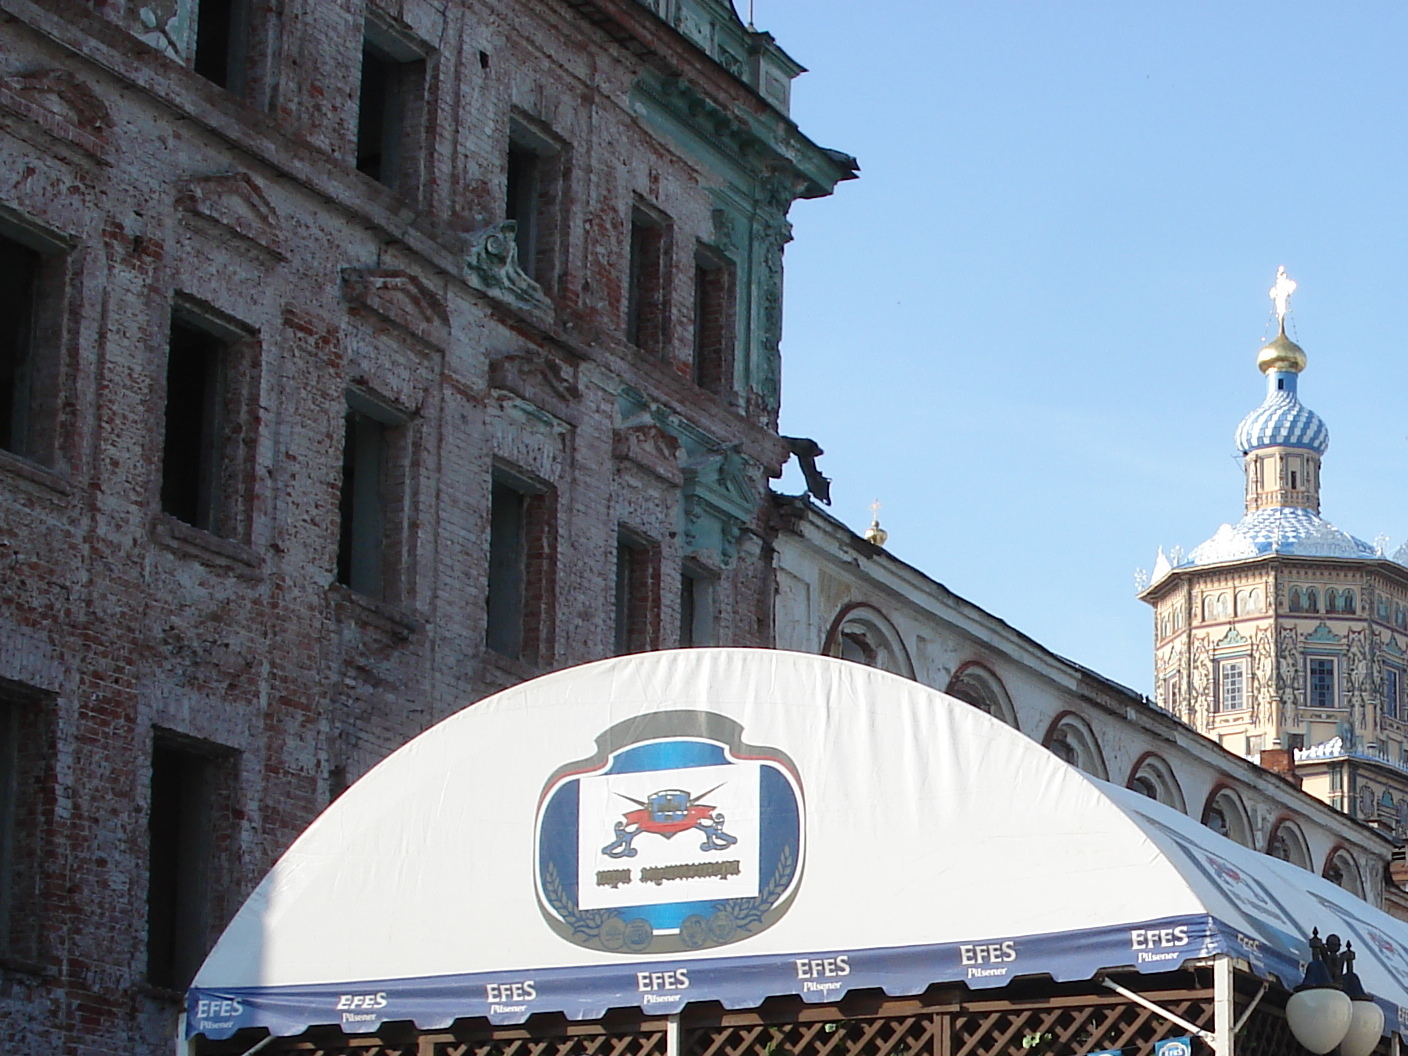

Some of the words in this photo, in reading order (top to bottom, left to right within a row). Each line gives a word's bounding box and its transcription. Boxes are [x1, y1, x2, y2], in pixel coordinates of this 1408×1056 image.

[1130, 925, 1189, 950] EFES
[959, 941, 1017, 965] EFES
[1138, 951, 1180, 963] Pilsener
[795, 955, 851, 979] EFES
[967, 967, 1008, 979] Pilsener
[486, 980, 537, 1003] EFES
[637, 968, 690, 992] EFES
[196, 999, 244, 1018] EFES
[336, 992, 388, 1010] EFES
